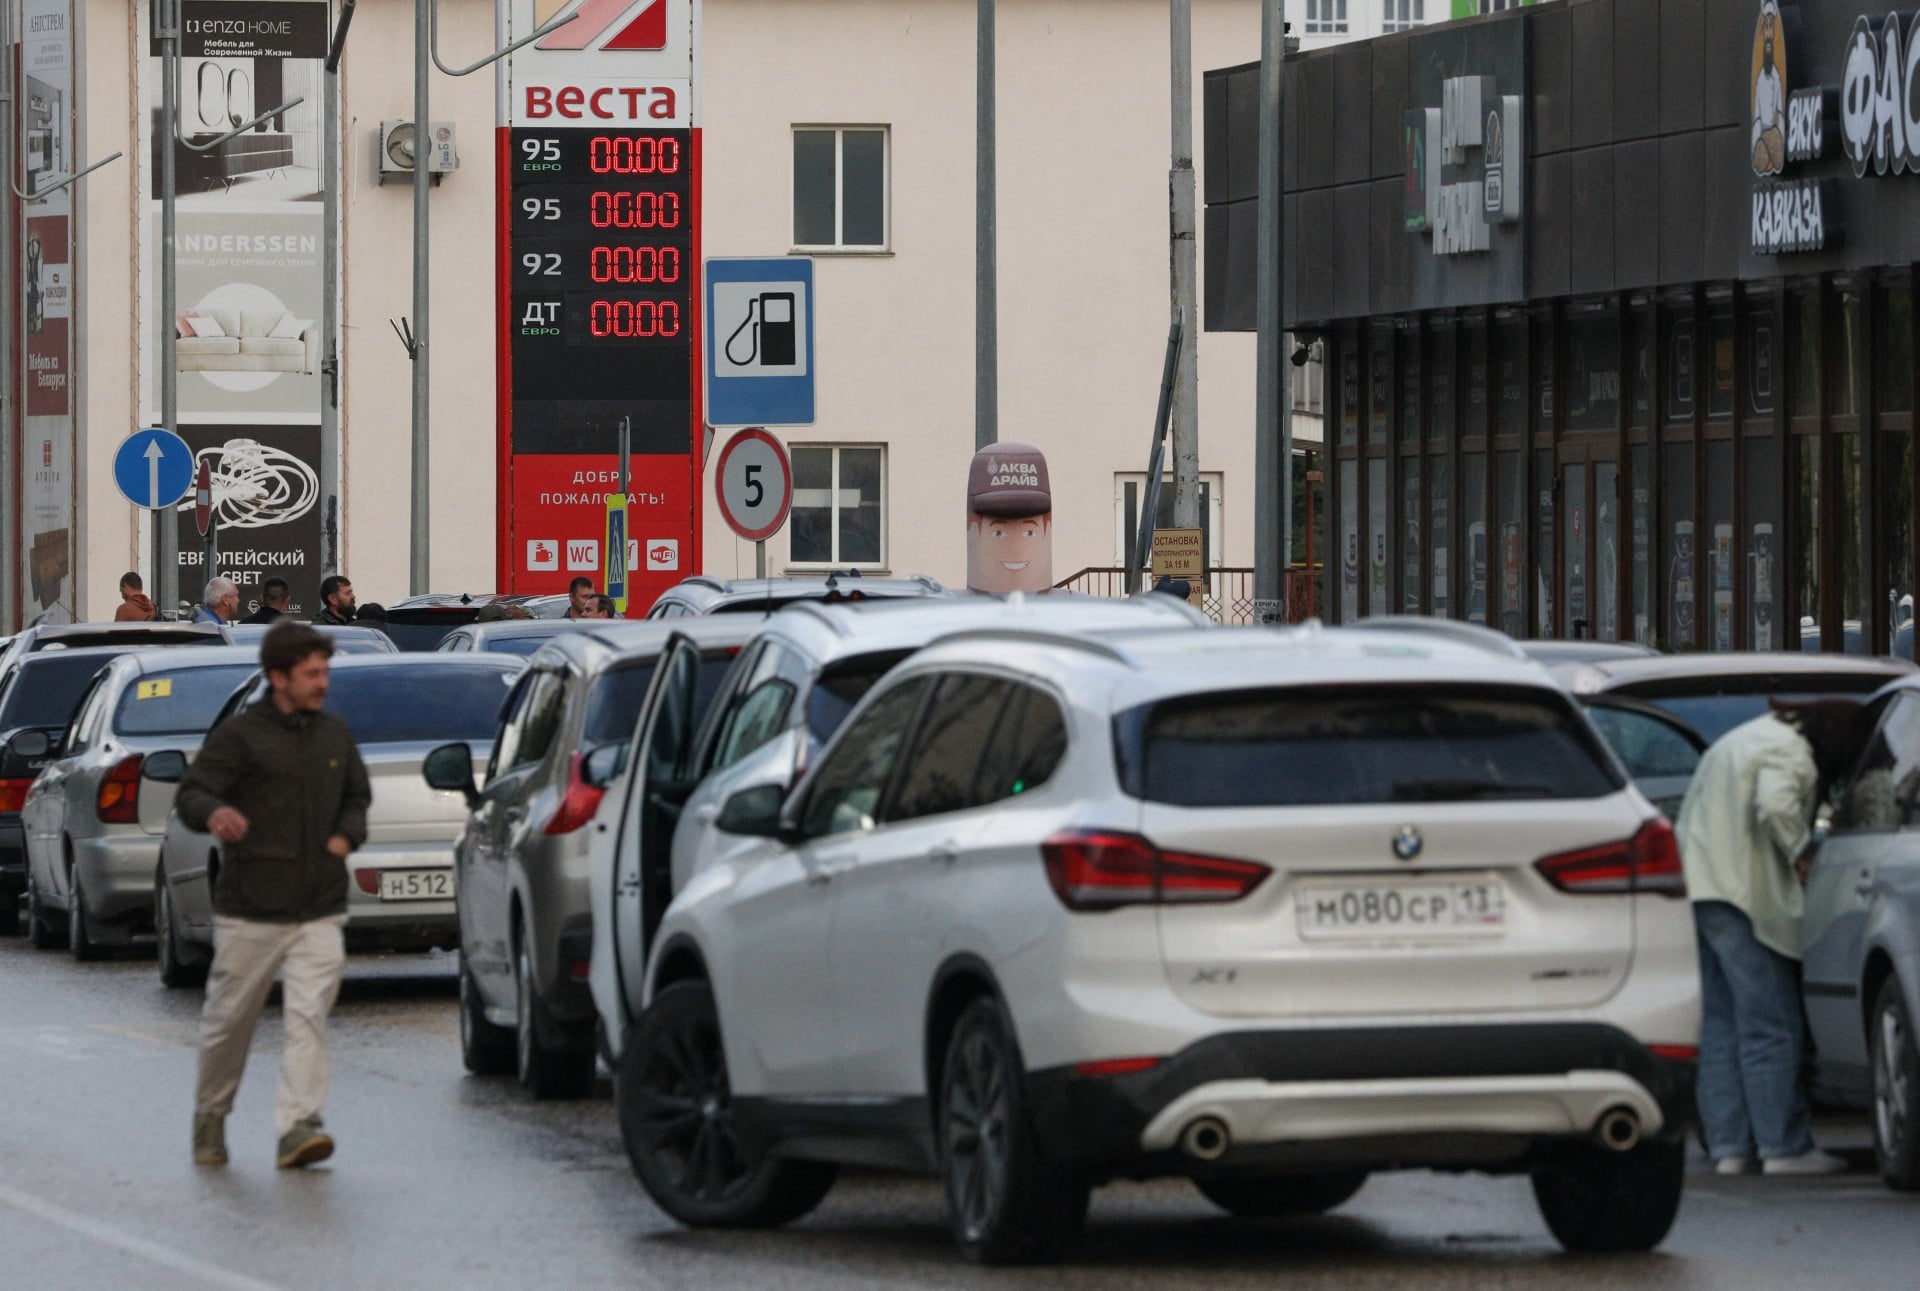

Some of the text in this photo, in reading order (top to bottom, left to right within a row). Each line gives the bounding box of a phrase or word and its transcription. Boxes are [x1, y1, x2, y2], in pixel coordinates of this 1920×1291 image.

[202, 20, 291, 34] enza HOME
[204, 40, 254, 49] Мебель для
[203, 48, 292, 57] Современной Жизни
[1787, 95, 1822, 154] ВКУС
[522, 138, 561, 161] 95
[523, 163, 562, 171] ЕВРО
[522, 198, 562, 220] 95
[1752, 186, 1823, 246] КАВКАЗА
[522, 253, 562, 275] 92
[522, 302, 561, 326] ДТ
[521, 327, 560, 336] ЕВРО
[999, 463, 1038, 474] АКВА
[745, 464, 763, 507] 5
[990, 473, 1038, 487] ДРАЙВ
[540, 493, 665, 504] ПОЖАЛАТЬ!
[1154, 536, 1199, 546] ОСТАНОВКА
[570, 546, 593, 563] WC
[1164, 560, 1190, 569] ЗА 15 М
[391, 874, 447, 895] Н512
